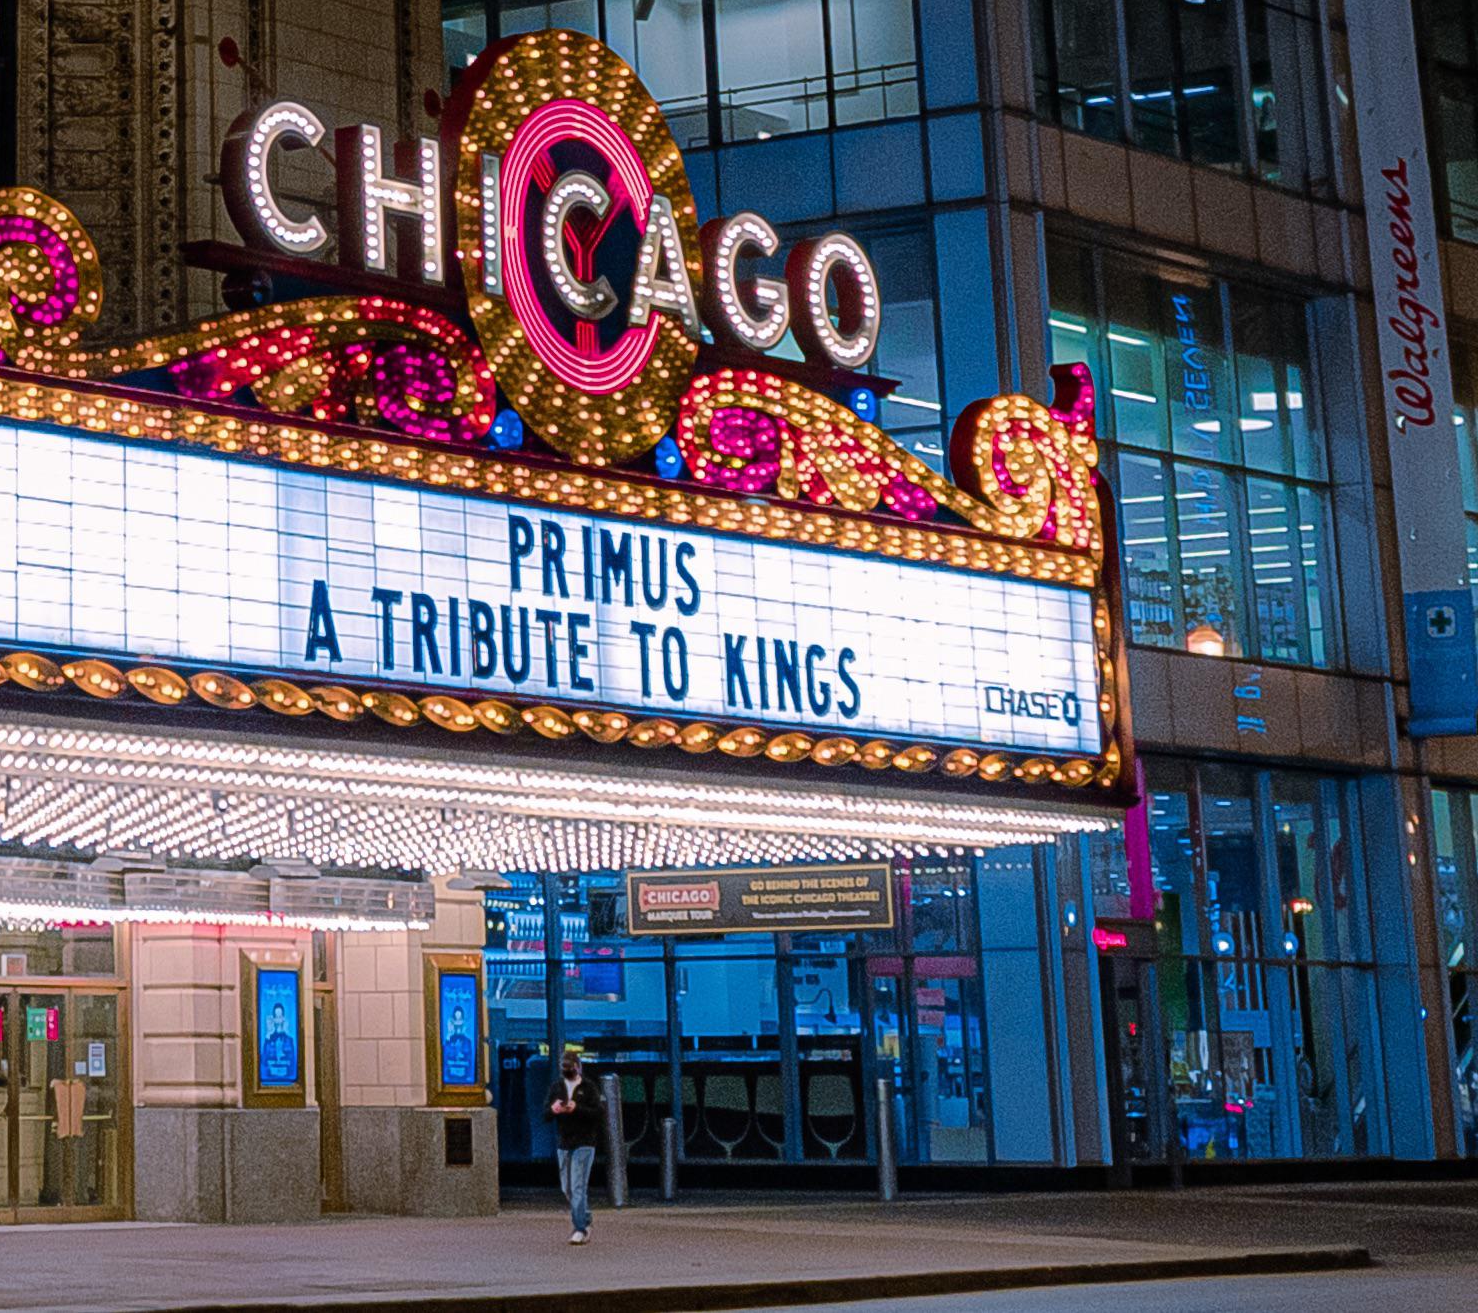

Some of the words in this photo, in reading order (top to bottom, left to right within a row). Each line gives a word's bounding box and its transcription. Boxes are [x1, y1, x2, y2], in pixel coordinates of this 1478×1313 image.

[245, 100, 882, 370] CHICAGO
[1380, 157, 1440, 435] Walgreens
[508, 514, 701, 616] PRIMUS
[305, 580, 342, 663] A
[372, 586, 595, 692] TRIBUTE
[630, 620, 689, 702] TO
[723, 632, 861, 719] KINGS
[984, 686, 1060, 721] CHASE
[646, 890, 711, 904] CHICAGO
[794, 892, 836, 904] CHICAGO
[801, 878, 819, 889] THE
